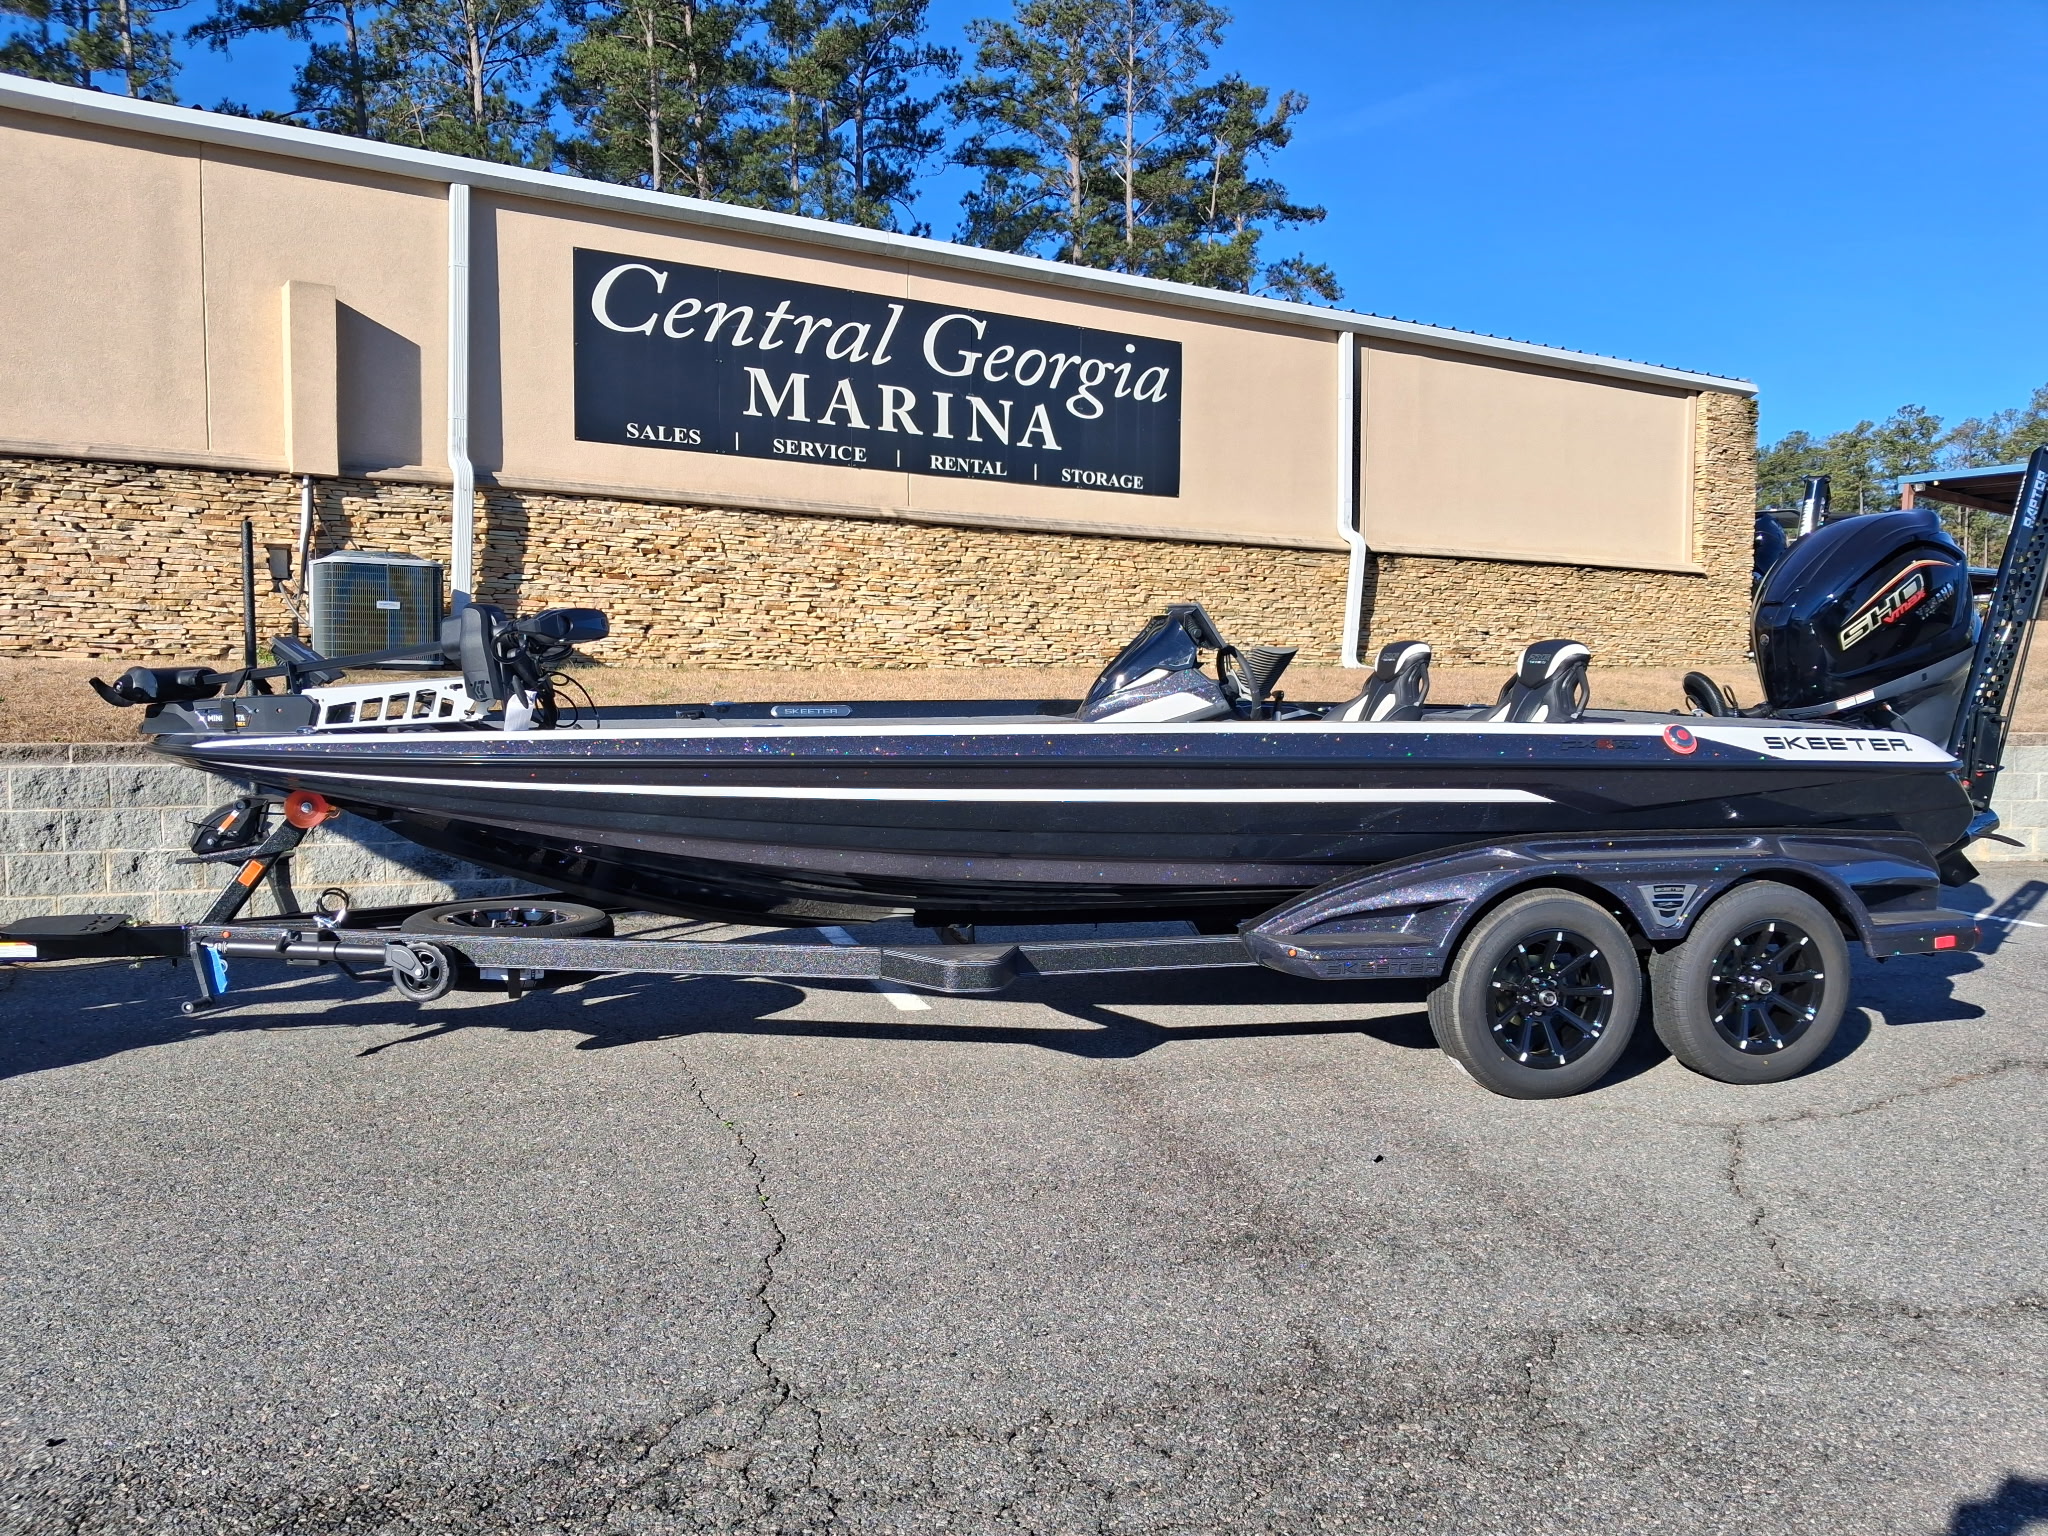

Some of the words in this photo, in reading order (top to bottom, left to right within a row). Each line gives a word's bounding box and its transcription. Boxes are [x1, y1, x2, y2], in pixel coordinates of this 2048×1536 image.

[591, 263, 904, 366] Central
[922, 313, 1169, 419] Georgia
[743, 366, 1062, 451] MARINA
[626, 422, 702, 445] SALES
[773, 438, 867, 463] SERVICE
[930, 454, 1008, 476] RENTAL
[1061, 468, 1144, 490] STORAGE
[2023, 470, 2047, 529] RAPTOR
[1841, 574, 1925, 651] SHO
[1915, 583, 1954, 620] YAMAHA
[1763, 736, 1910, 751] SKEETER
[1327, 961, 1439, 975] SKEETER
